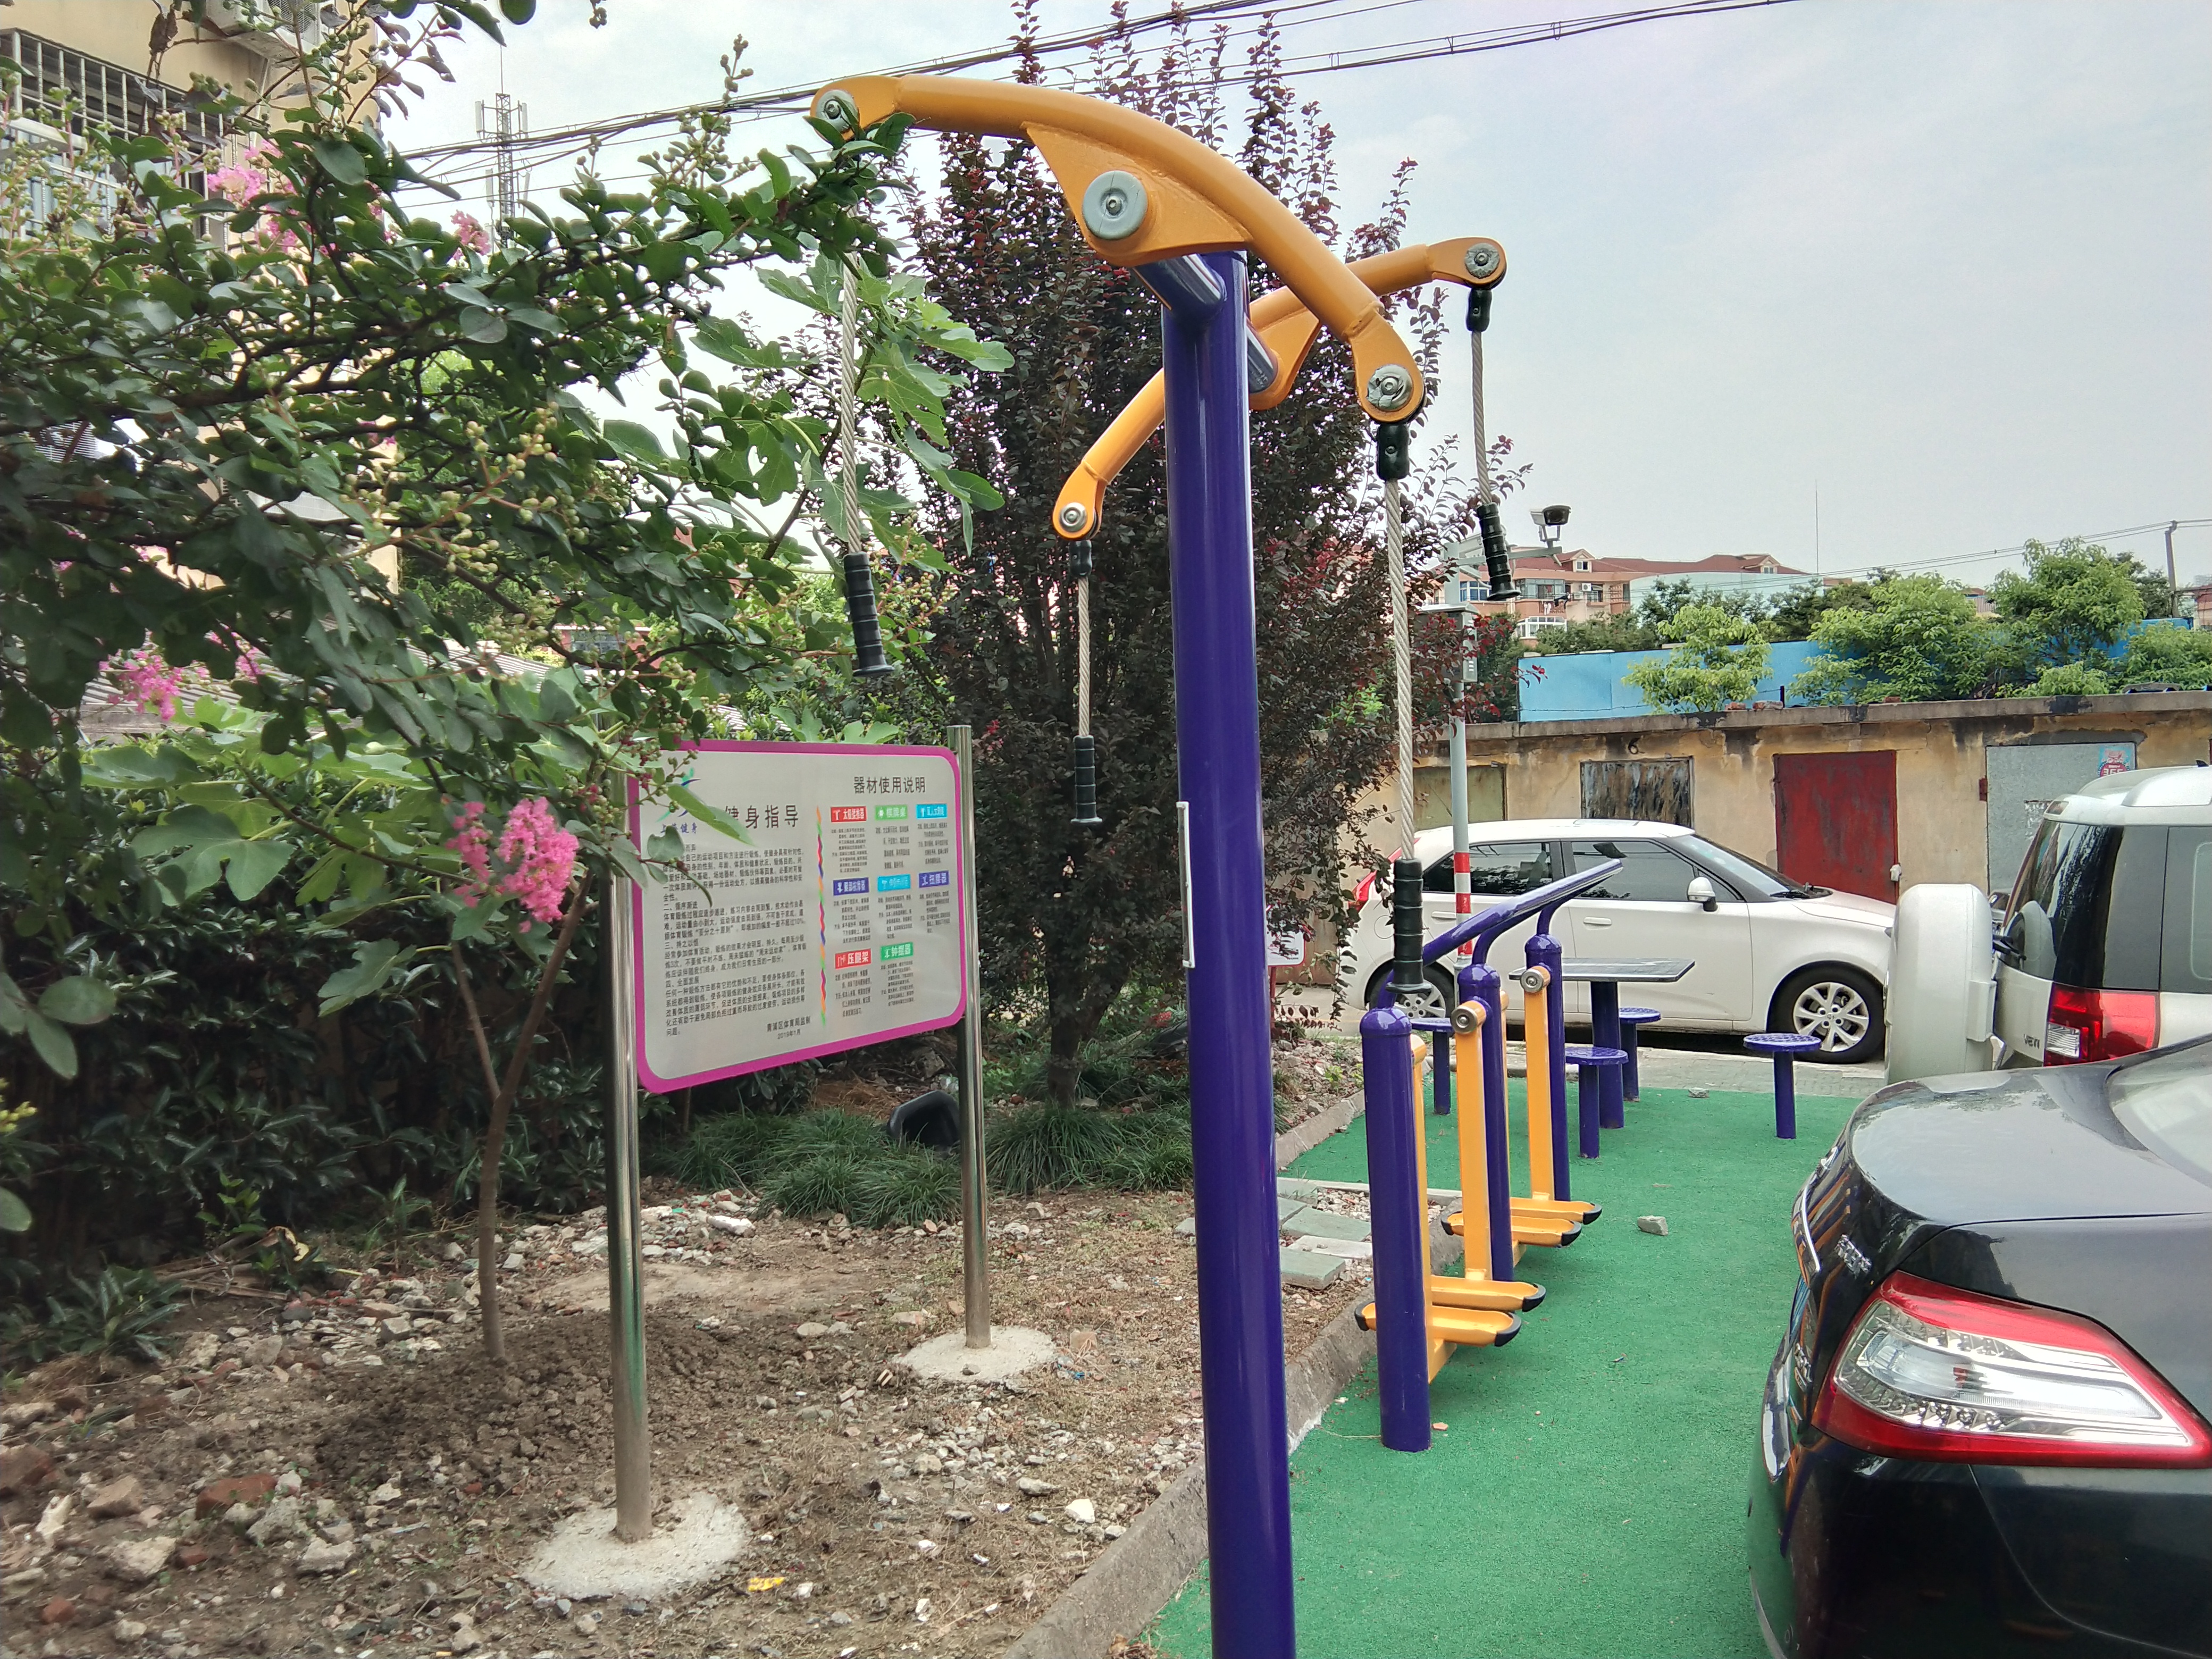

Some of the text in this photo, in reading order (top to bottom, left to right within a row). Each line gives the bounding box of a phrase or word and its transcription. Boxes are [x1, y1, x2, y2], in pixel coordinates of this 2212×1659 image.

[853, 776, 925, 793] 器材使用说明
[847, 951, 869, 965] 压腿架
